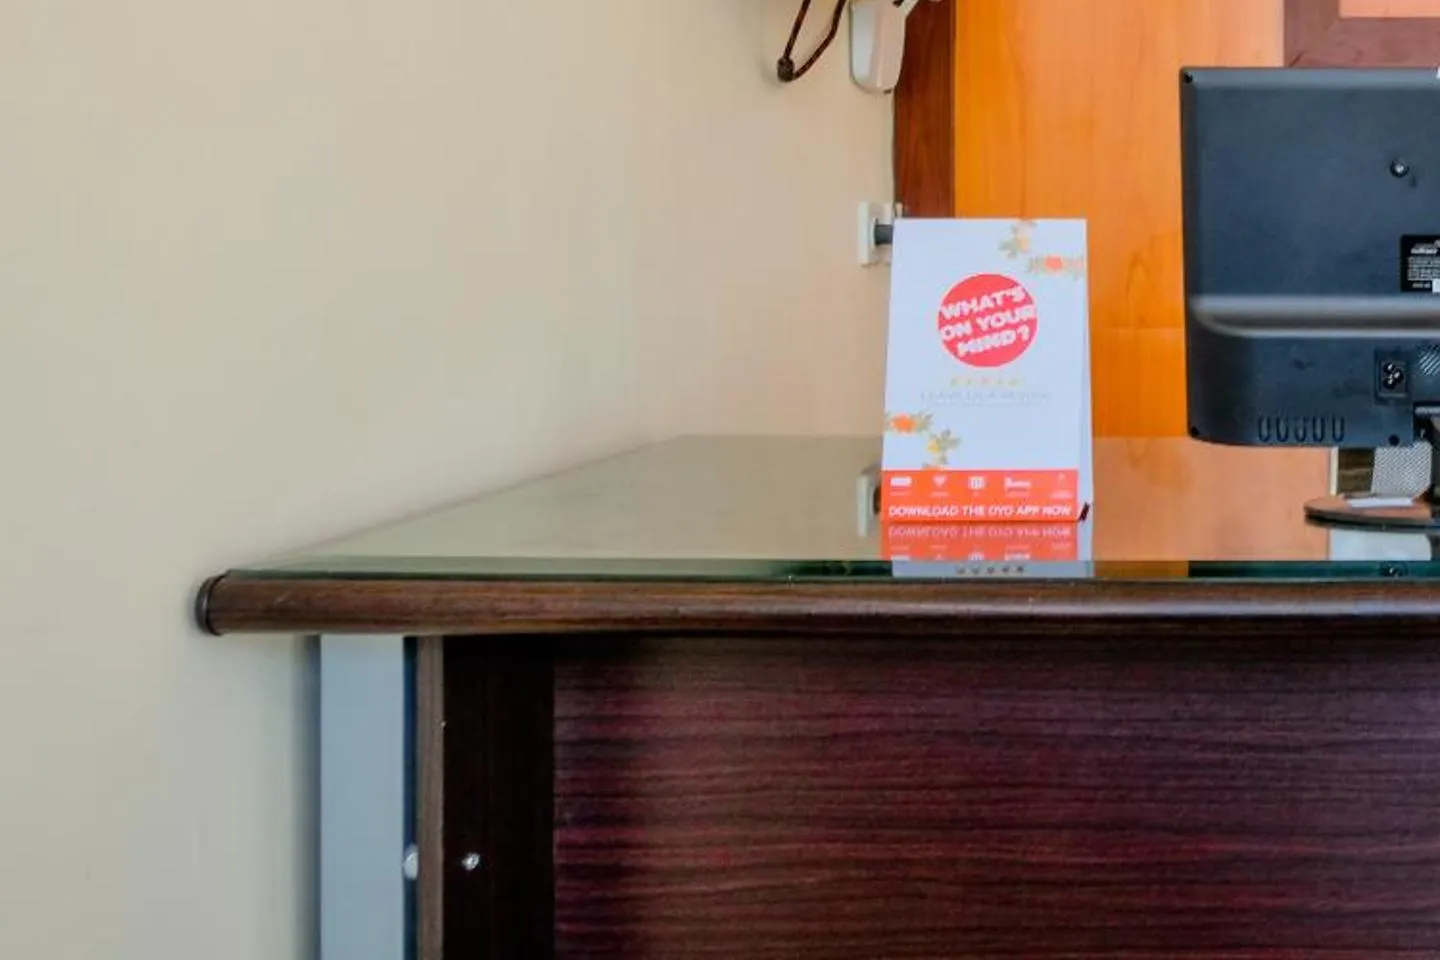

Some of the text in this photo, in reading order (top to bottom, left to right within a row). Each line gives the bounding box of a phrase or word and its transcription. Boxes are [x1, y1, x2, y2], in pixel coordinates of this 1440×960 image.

[941, 286, 1026, 320] WHAT'S
[940, 304, 1037, 341] ON YOUR
[957, 325, 1031, 358] MIND?
[888, 504, 1071, 517] DOWNLOAD THE OYO APP NOW
